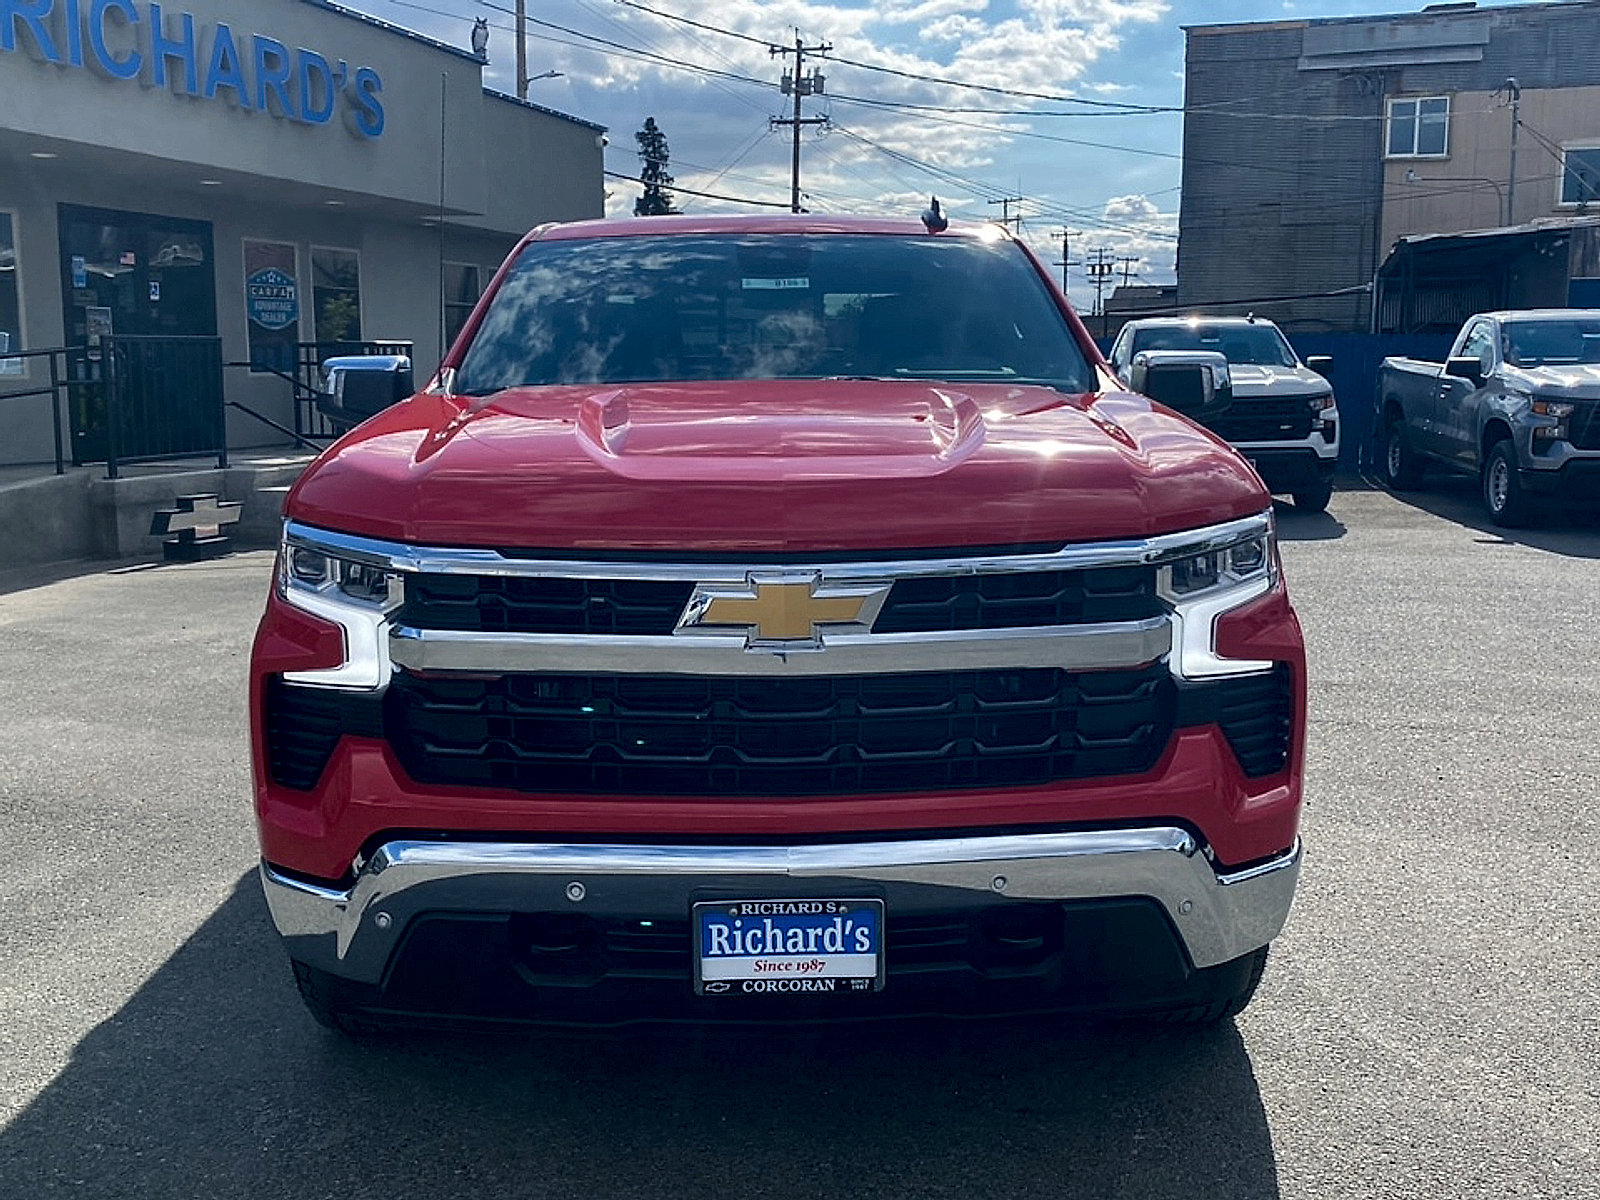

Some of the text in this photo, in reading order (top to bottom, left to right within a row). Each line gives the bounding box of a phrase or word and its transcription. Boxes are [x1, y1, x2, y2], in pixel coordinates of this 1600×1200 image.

[0, 0, 385, 138] RICHARD'S
[741, 902, 837, 915] RICHARDS
[708, 917, 870, 955] Richard's
[754, 959, 827, 973] Since 1987
[742, 979, 836, 993] CORCORAN
